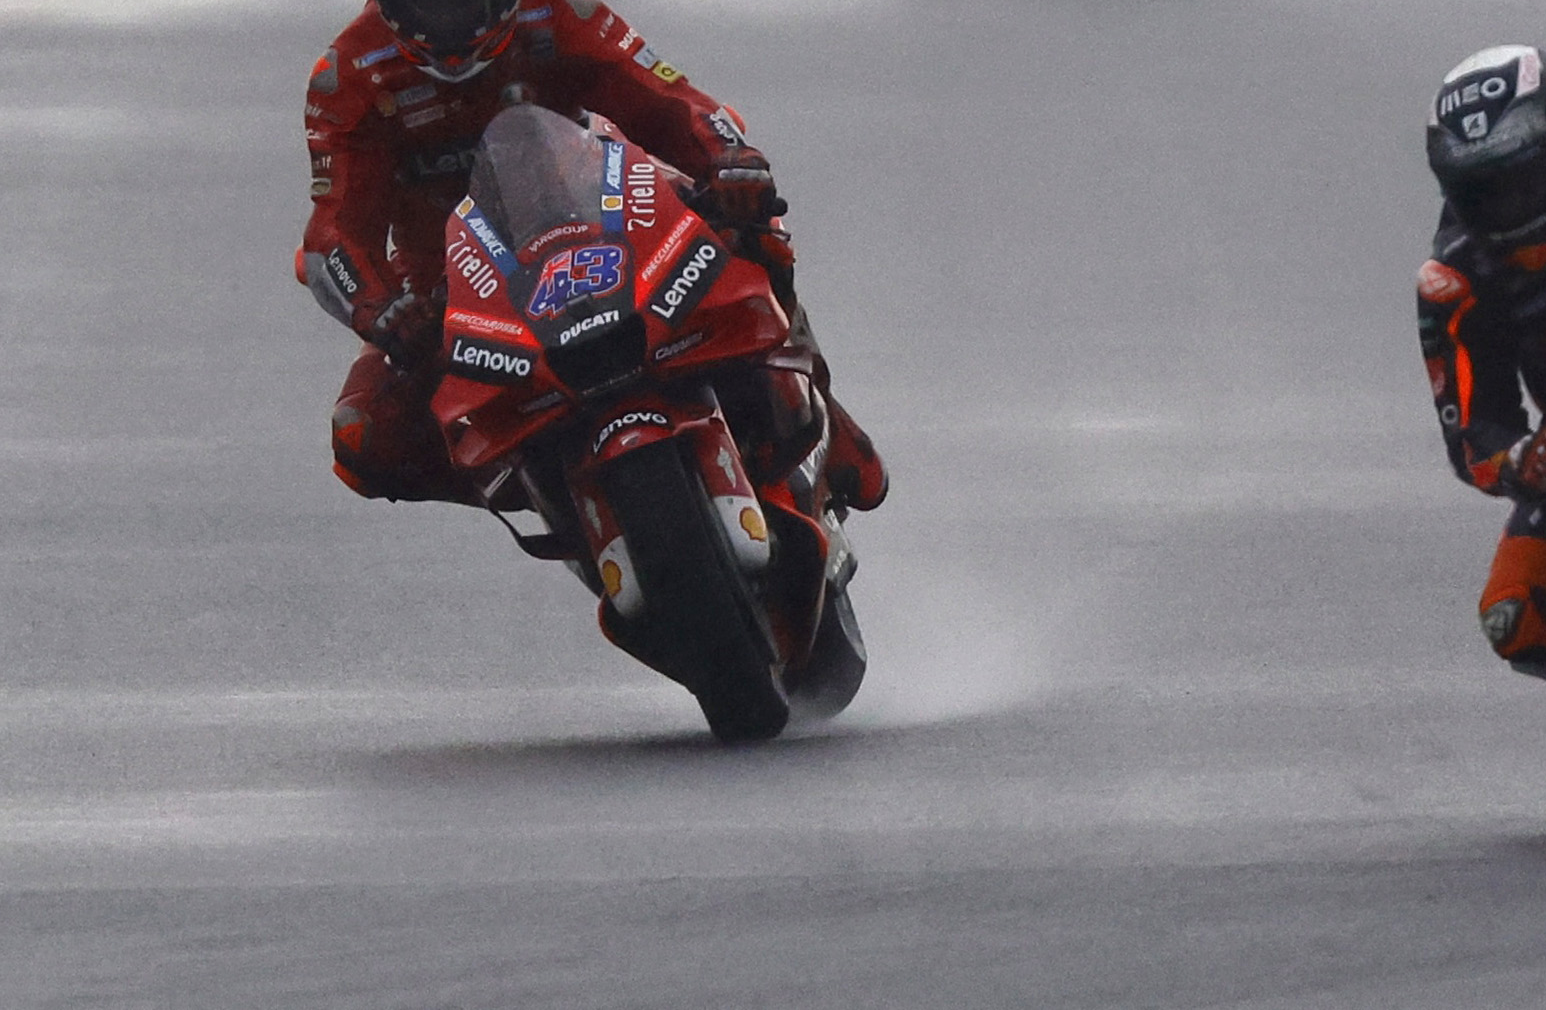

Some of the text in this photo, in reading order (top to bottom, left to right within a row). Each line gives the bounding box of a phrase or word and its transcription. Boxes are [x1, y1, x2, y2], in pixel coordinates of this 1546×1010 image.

[1440, 76, 1507, 116] MEO
[328, 247, 357, 294] Lenovo
[526, 244, 624, 317] 43
[651, 244, 716, 319] Lenovo
[560, 309, 620, 346] DUCATI
[453, 340, 531, 377] Lenovo
